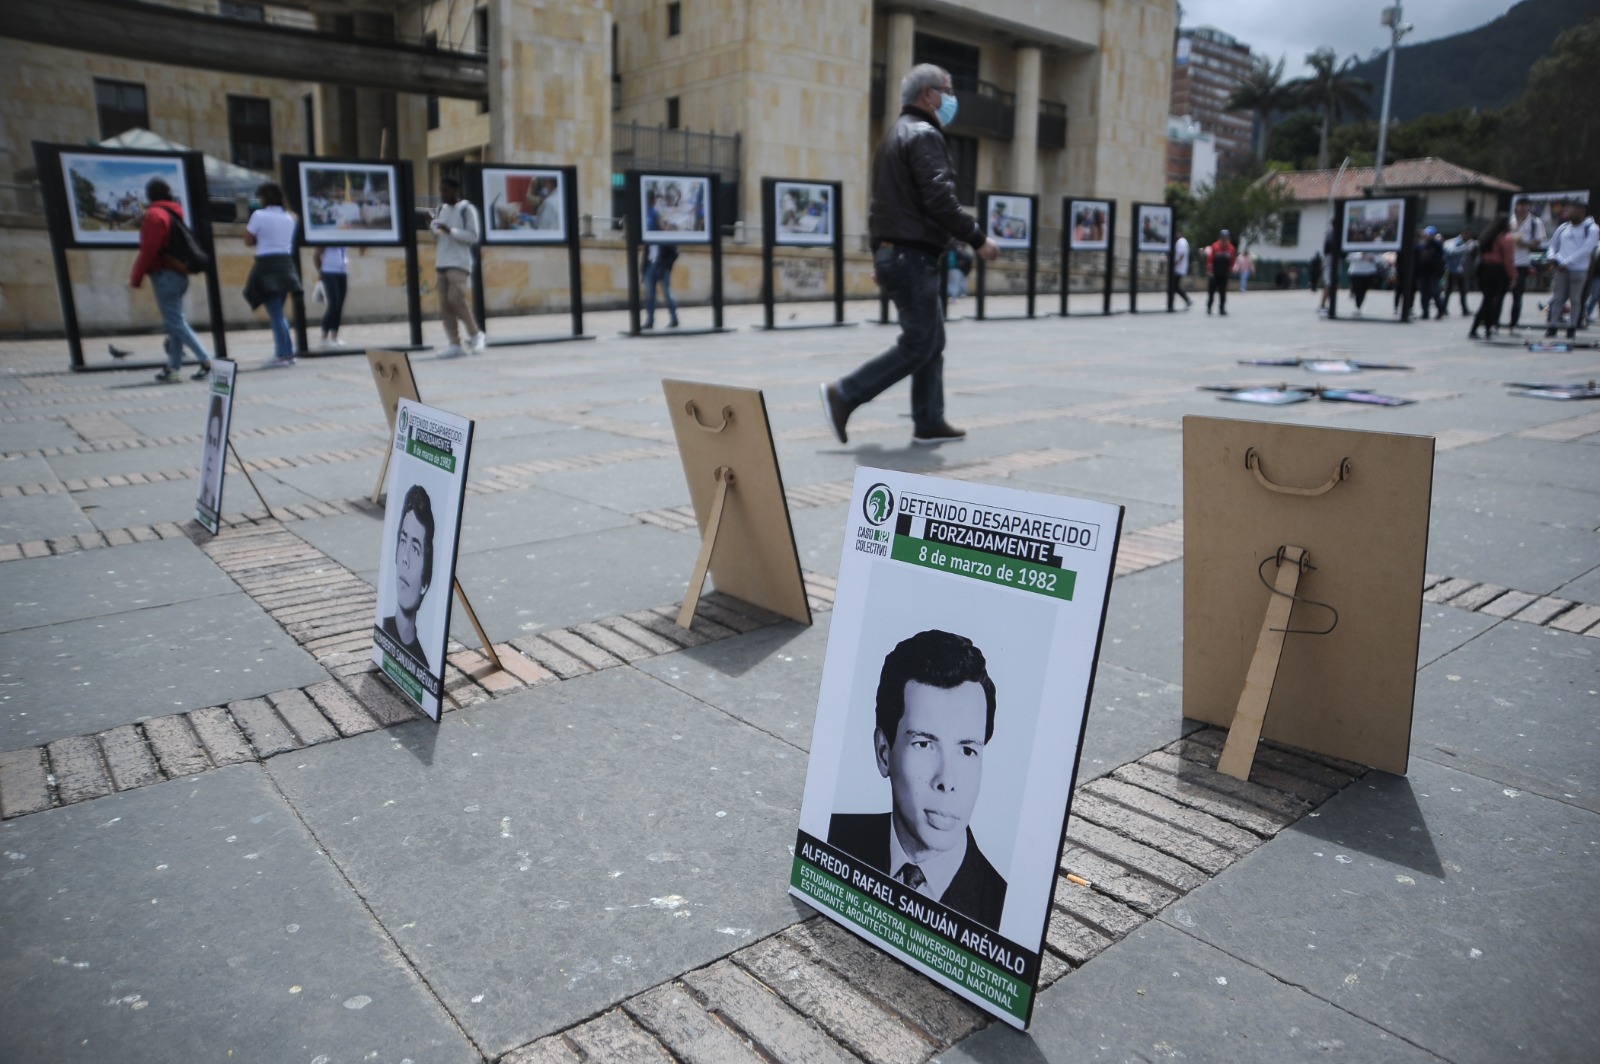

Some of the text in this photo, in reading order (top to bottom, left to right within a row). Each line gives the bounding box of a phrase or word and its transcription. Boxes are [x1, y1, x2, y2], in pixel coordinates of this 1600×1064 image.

[429, 421, 462, 442] DESAPARECIDO
[434, 454, 440, 464] de
[440, 456, 452, 469] 1982
[857, 526, 874, 540] CASO
[899, 496, 1091, 546] DETENIDO DESAPARECIDO
[855, 539, 888, 557] COLECTIVO
[930, 522, 1049, 562] FORZADAMENTE
[918, 545, 1056, 592] 8 de marzo de 1982
[416, 666, 438, 694] ARÉVALO
[801, 842, 1025, 975] ALFREDO RAFAEL SANJUÁN ARÉVALO
[800, 865, 1019, 997] ESTUDIANTE ING. CATASTRAL UNIVERSIDAD DISTRITAL
[800, 879, 1013, 1010] ESTUDIANTE ARQUITECTURA UNIVERSIDAD NACIONAL
